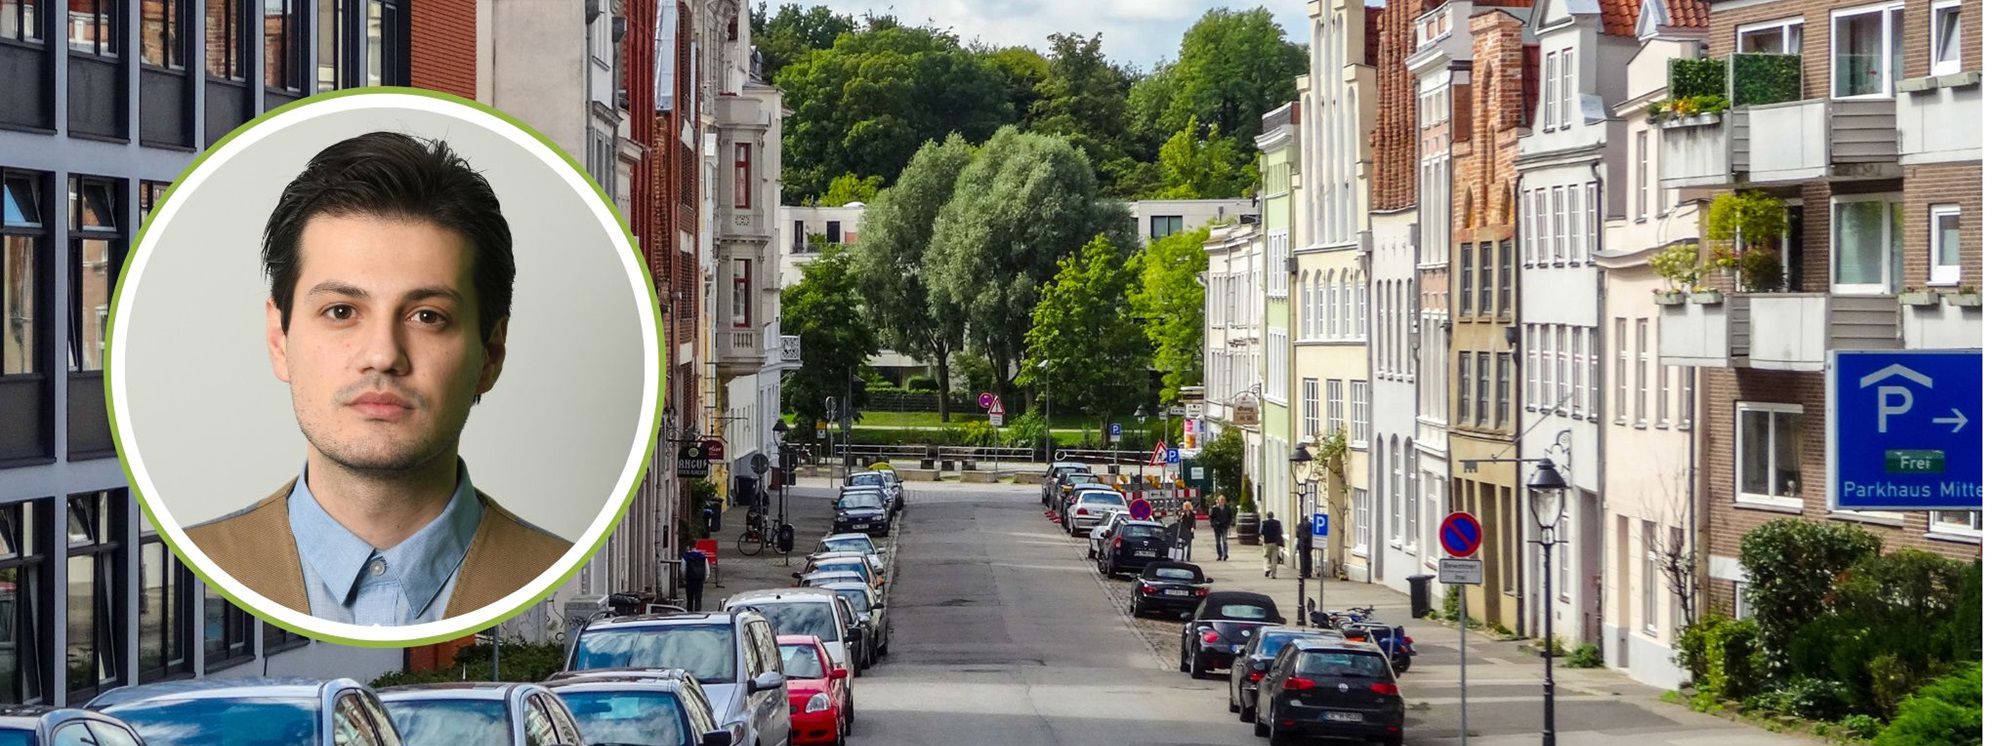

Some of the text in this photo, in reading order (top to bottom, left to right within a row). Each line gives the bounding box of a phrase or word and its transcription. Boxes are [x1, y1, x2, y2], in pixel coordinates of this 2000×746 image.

[1878, 386, 1914, 433] P
[1169, 450, 1176, 462] P
[1900, 456, 1933, 470] Frei
[1844, 481, 1931, 497] Parkhaus
[1316, 516, 1326, 533] P
